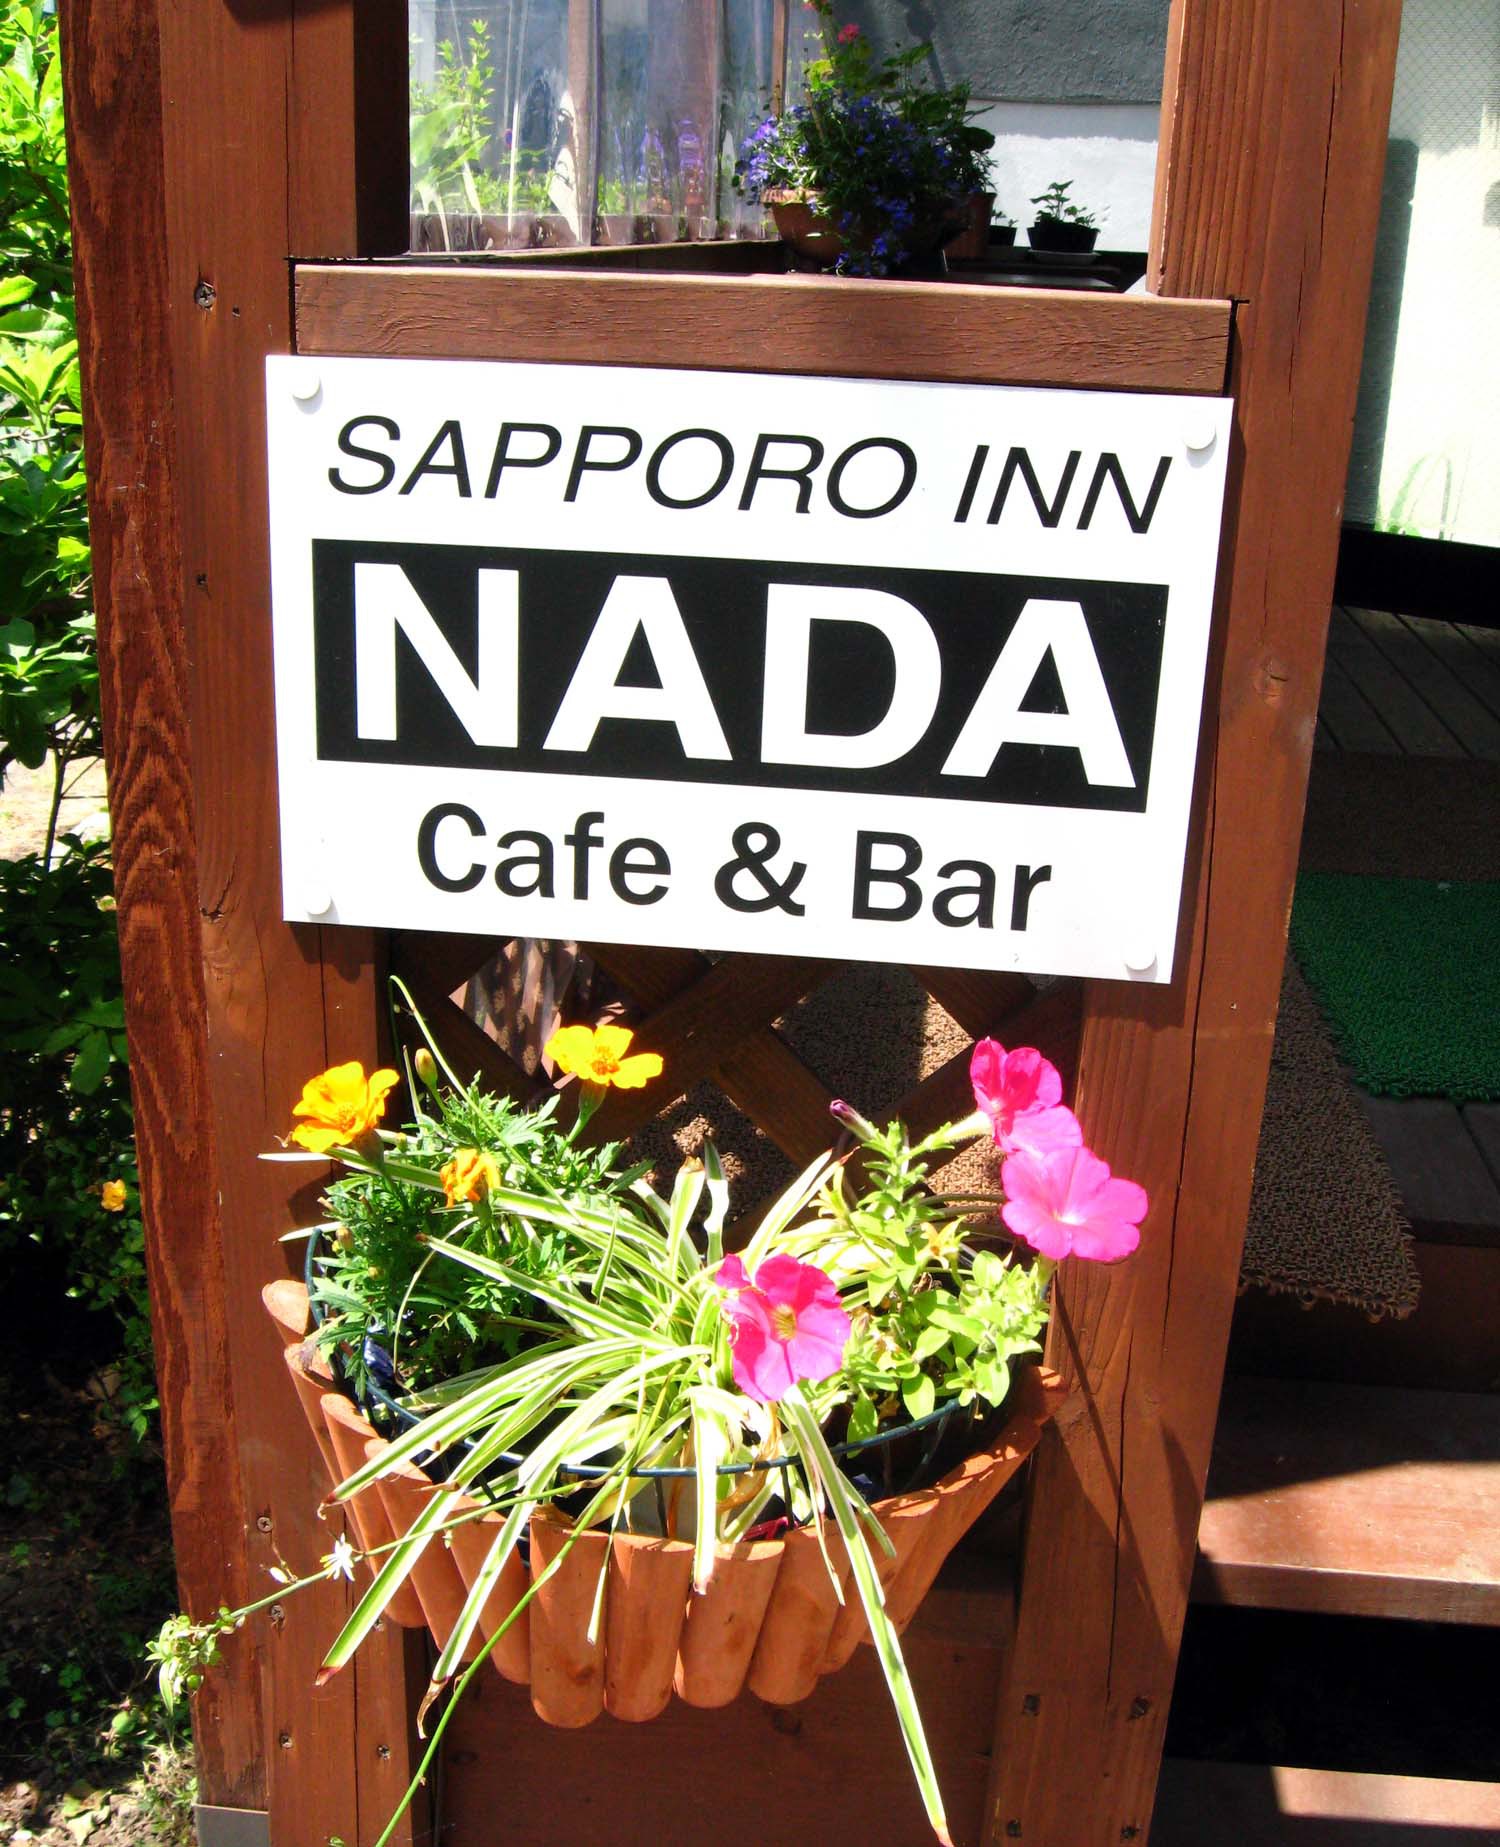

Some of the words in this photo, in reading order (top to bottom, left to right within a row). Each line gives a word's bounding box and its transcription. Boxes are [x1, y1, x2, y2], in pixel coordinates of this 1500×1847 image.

[328, 415, 917, 519] SAPPORO
[953, 444, 1173, 534] INN
[354, 562, 1137, 788] NADA
[417, 802, 671, 906] Cafe
[714, 821, 807, 917] &
[852, 830, 1052, 932] Bar
